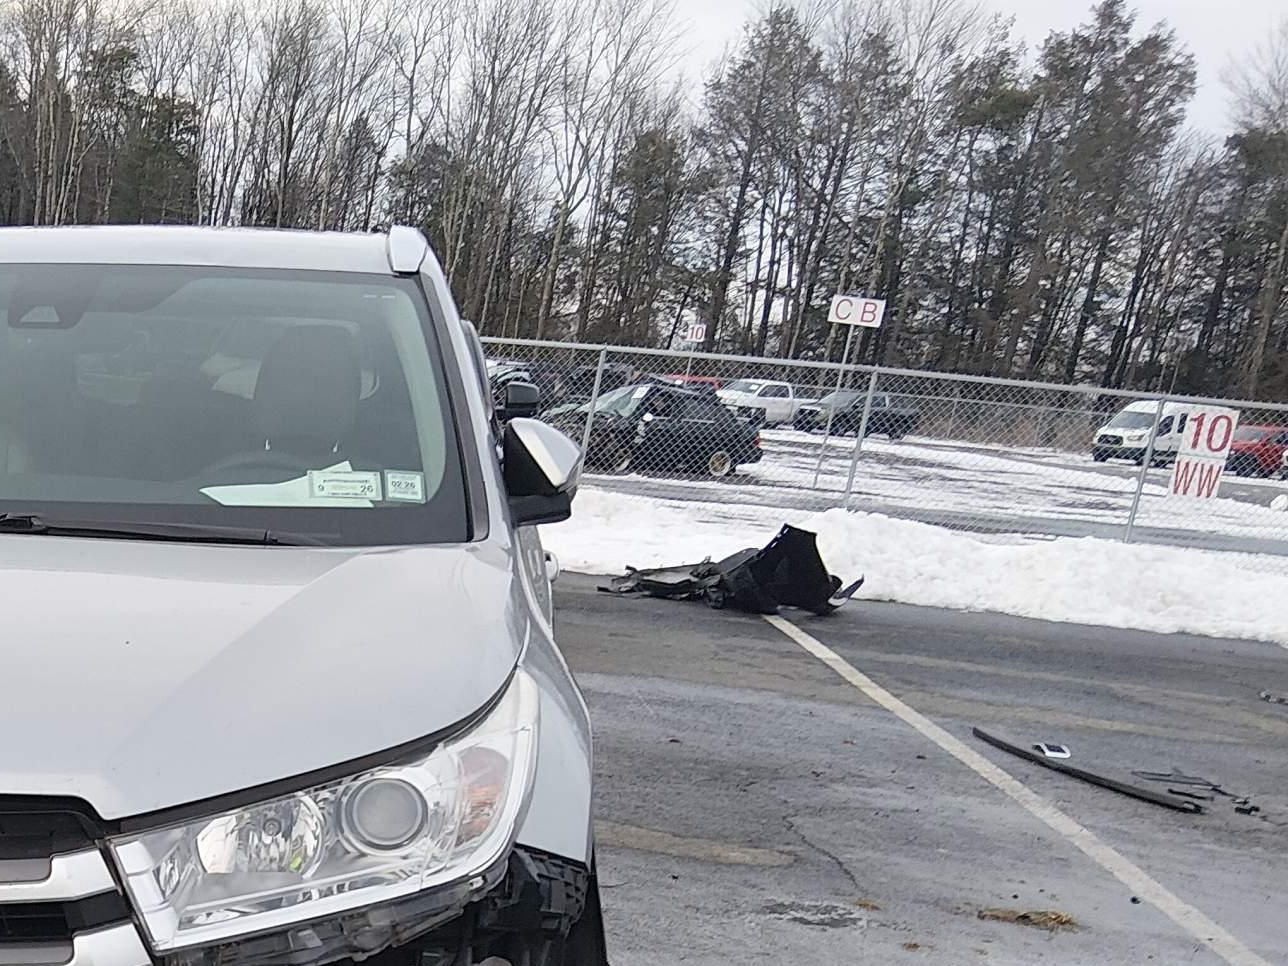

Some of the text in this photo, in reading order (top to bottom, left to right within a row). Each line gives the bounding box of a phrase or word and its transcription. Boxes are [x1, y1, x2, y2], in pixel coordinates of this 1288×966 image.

[688, 326, 704, 340] 10
[1189, 412, 1233, 453] 10
[360, 484, 374, 493] 26
[1173, 460, 1222, 499] WW
